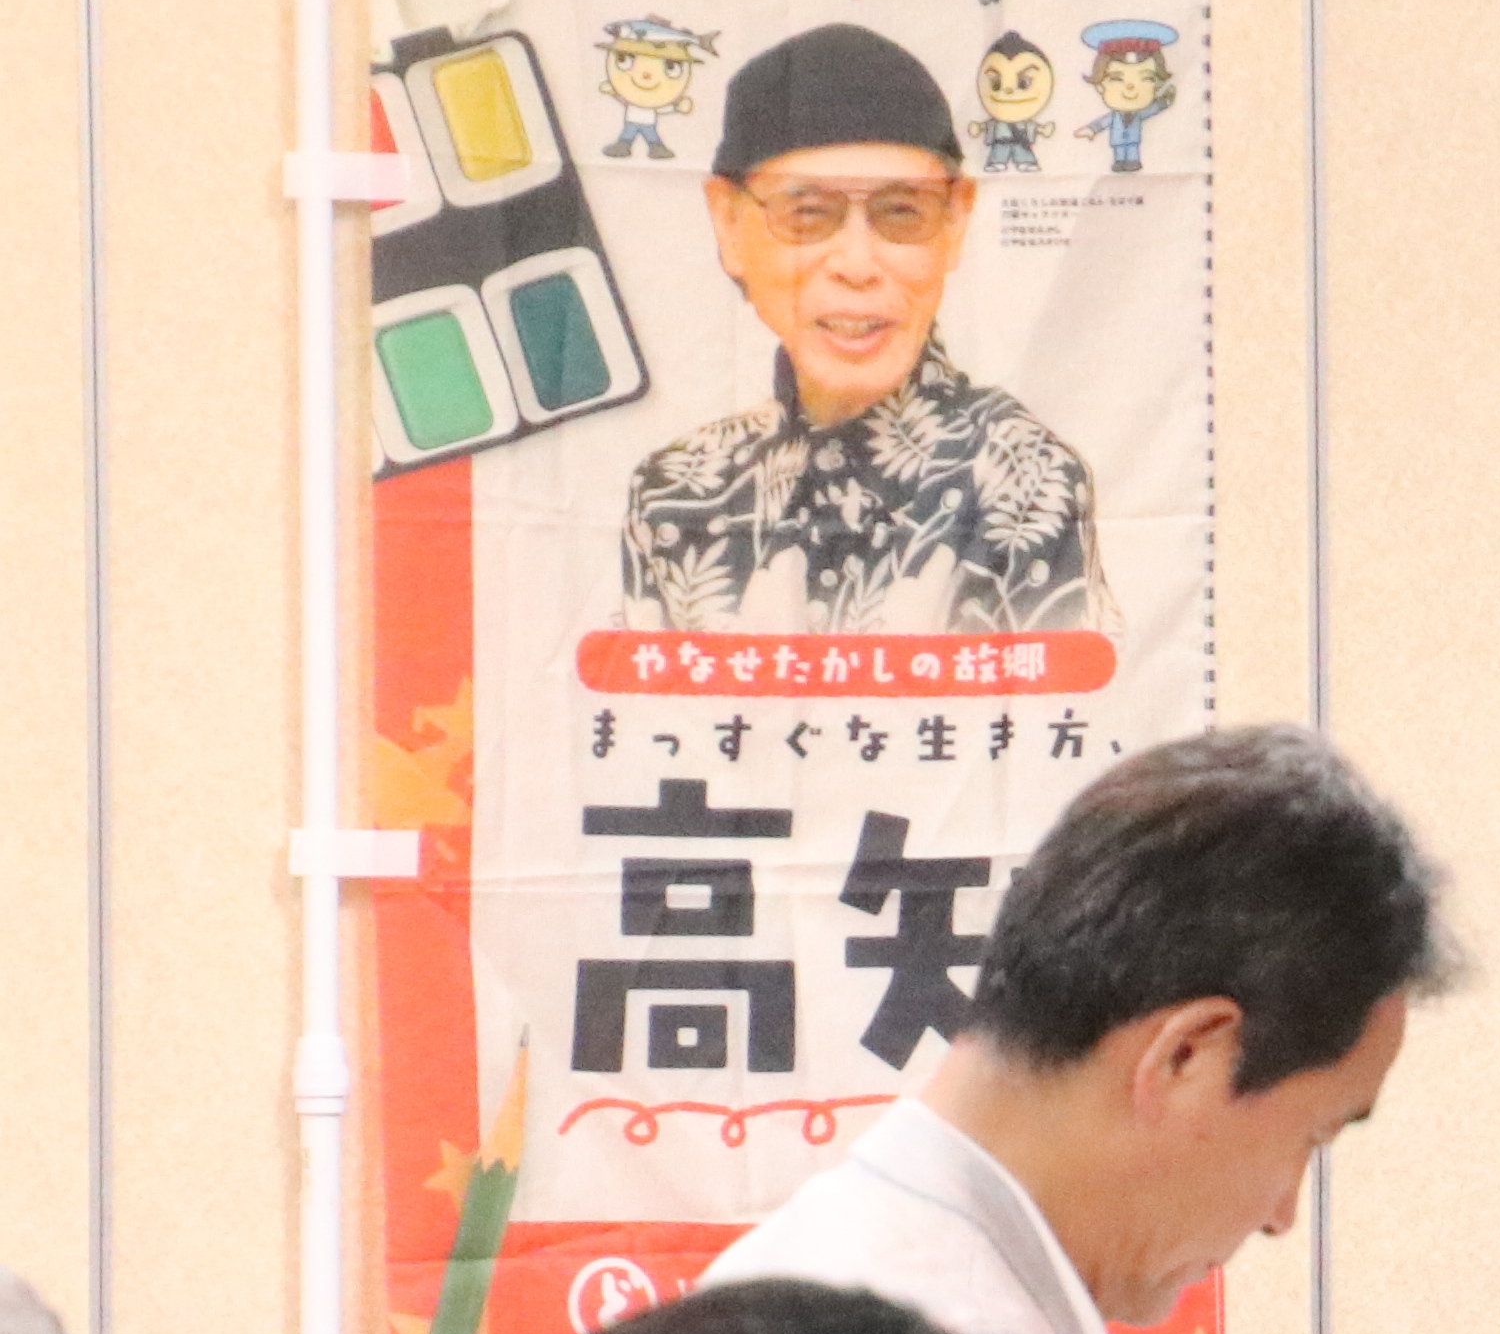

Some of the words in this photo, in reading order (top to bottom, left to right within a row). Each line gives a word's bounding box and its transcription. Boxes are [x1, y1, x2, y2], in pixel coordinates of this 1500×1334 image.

[631, 641, 1046, 685] やなせたかしの故郷
[591, 709, 1122, 762] まっすぐな生き方、
